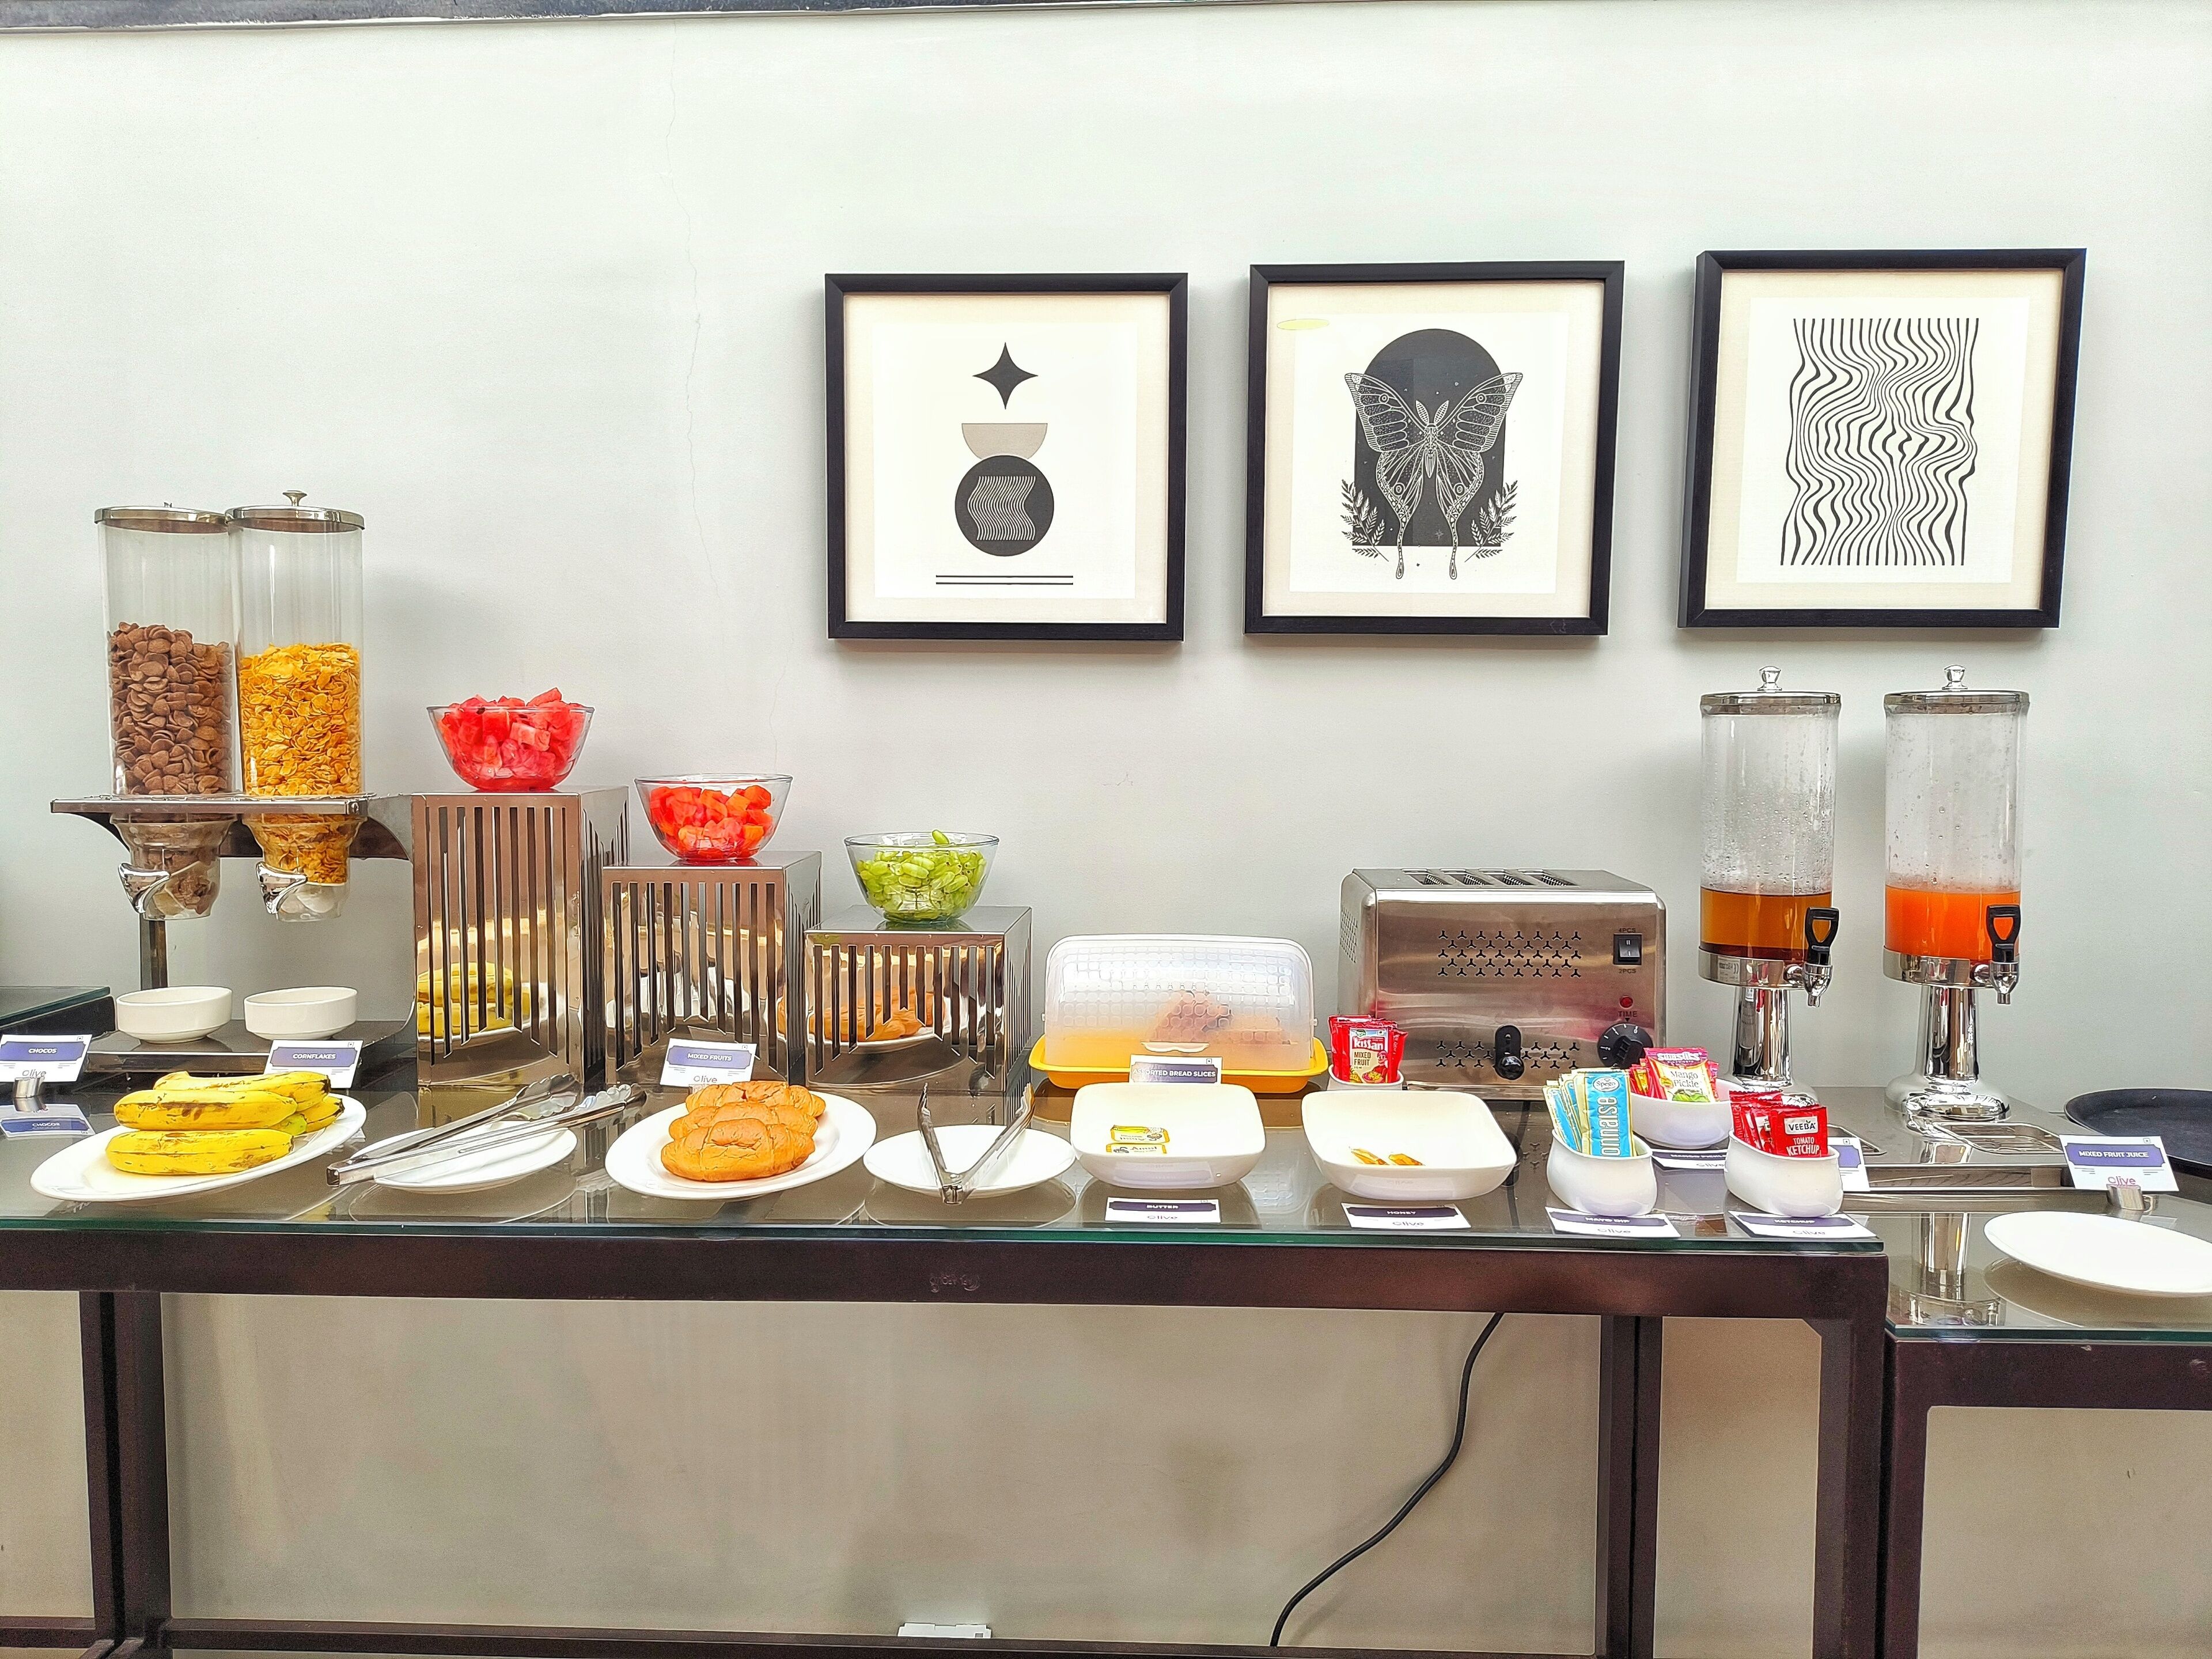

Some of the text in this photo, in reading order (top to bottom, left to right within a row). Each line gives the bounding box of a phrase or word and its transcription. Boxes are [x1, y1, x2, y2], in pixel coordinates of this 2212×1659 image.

[22, 1069, 46, 1077] Olive
[1671, 1071, 1698, 1080] Mango
[1788, 1123, 1816, 1131] VEEBA
[1792, 1137, 1815, 1145] TOMATO
[1786, 1144, 1820, 1157] KETCHUP
[2108, 1176, 2136, 1185] Olive
